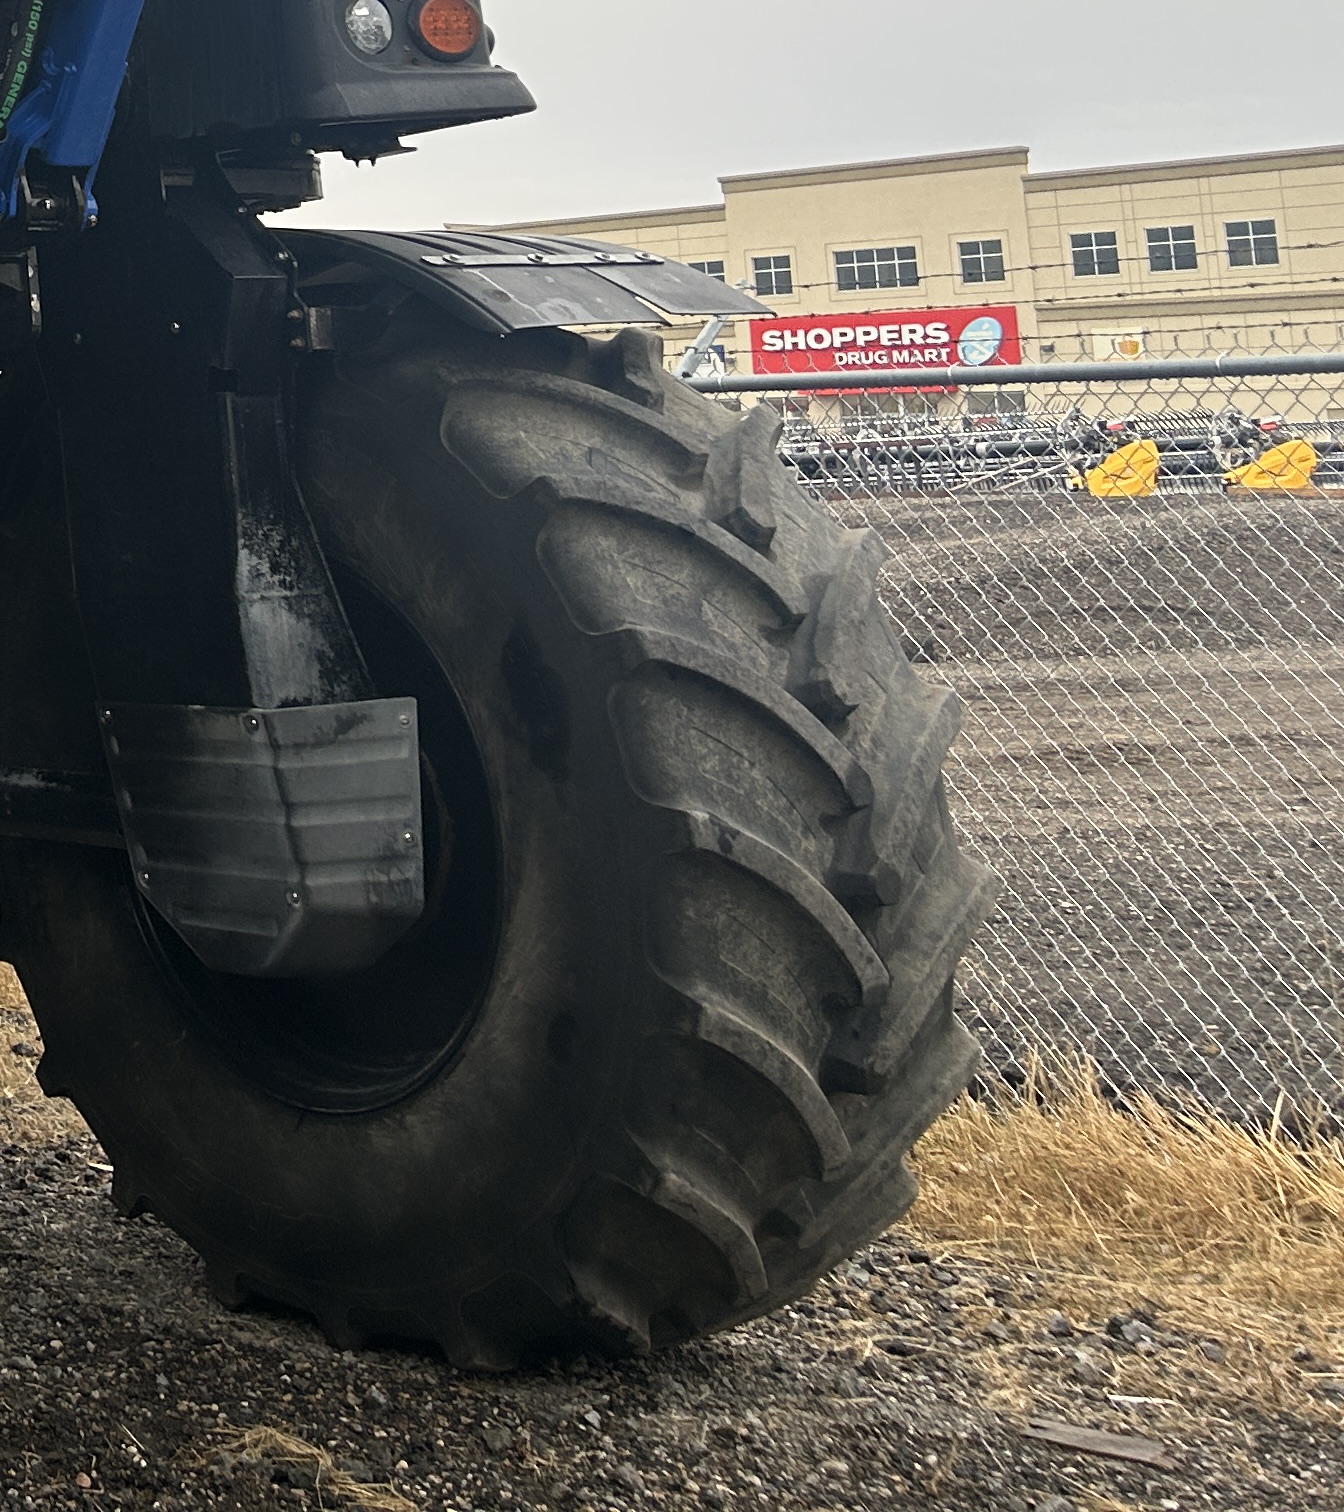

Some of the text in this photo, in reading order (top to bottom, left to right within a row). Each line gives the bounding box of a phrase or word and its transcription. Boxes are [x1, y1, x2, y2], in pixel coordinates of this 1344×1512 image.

[761, 321, 950, 352] SHOPPERS
[834, 347, 951, 366] DRUG MART
